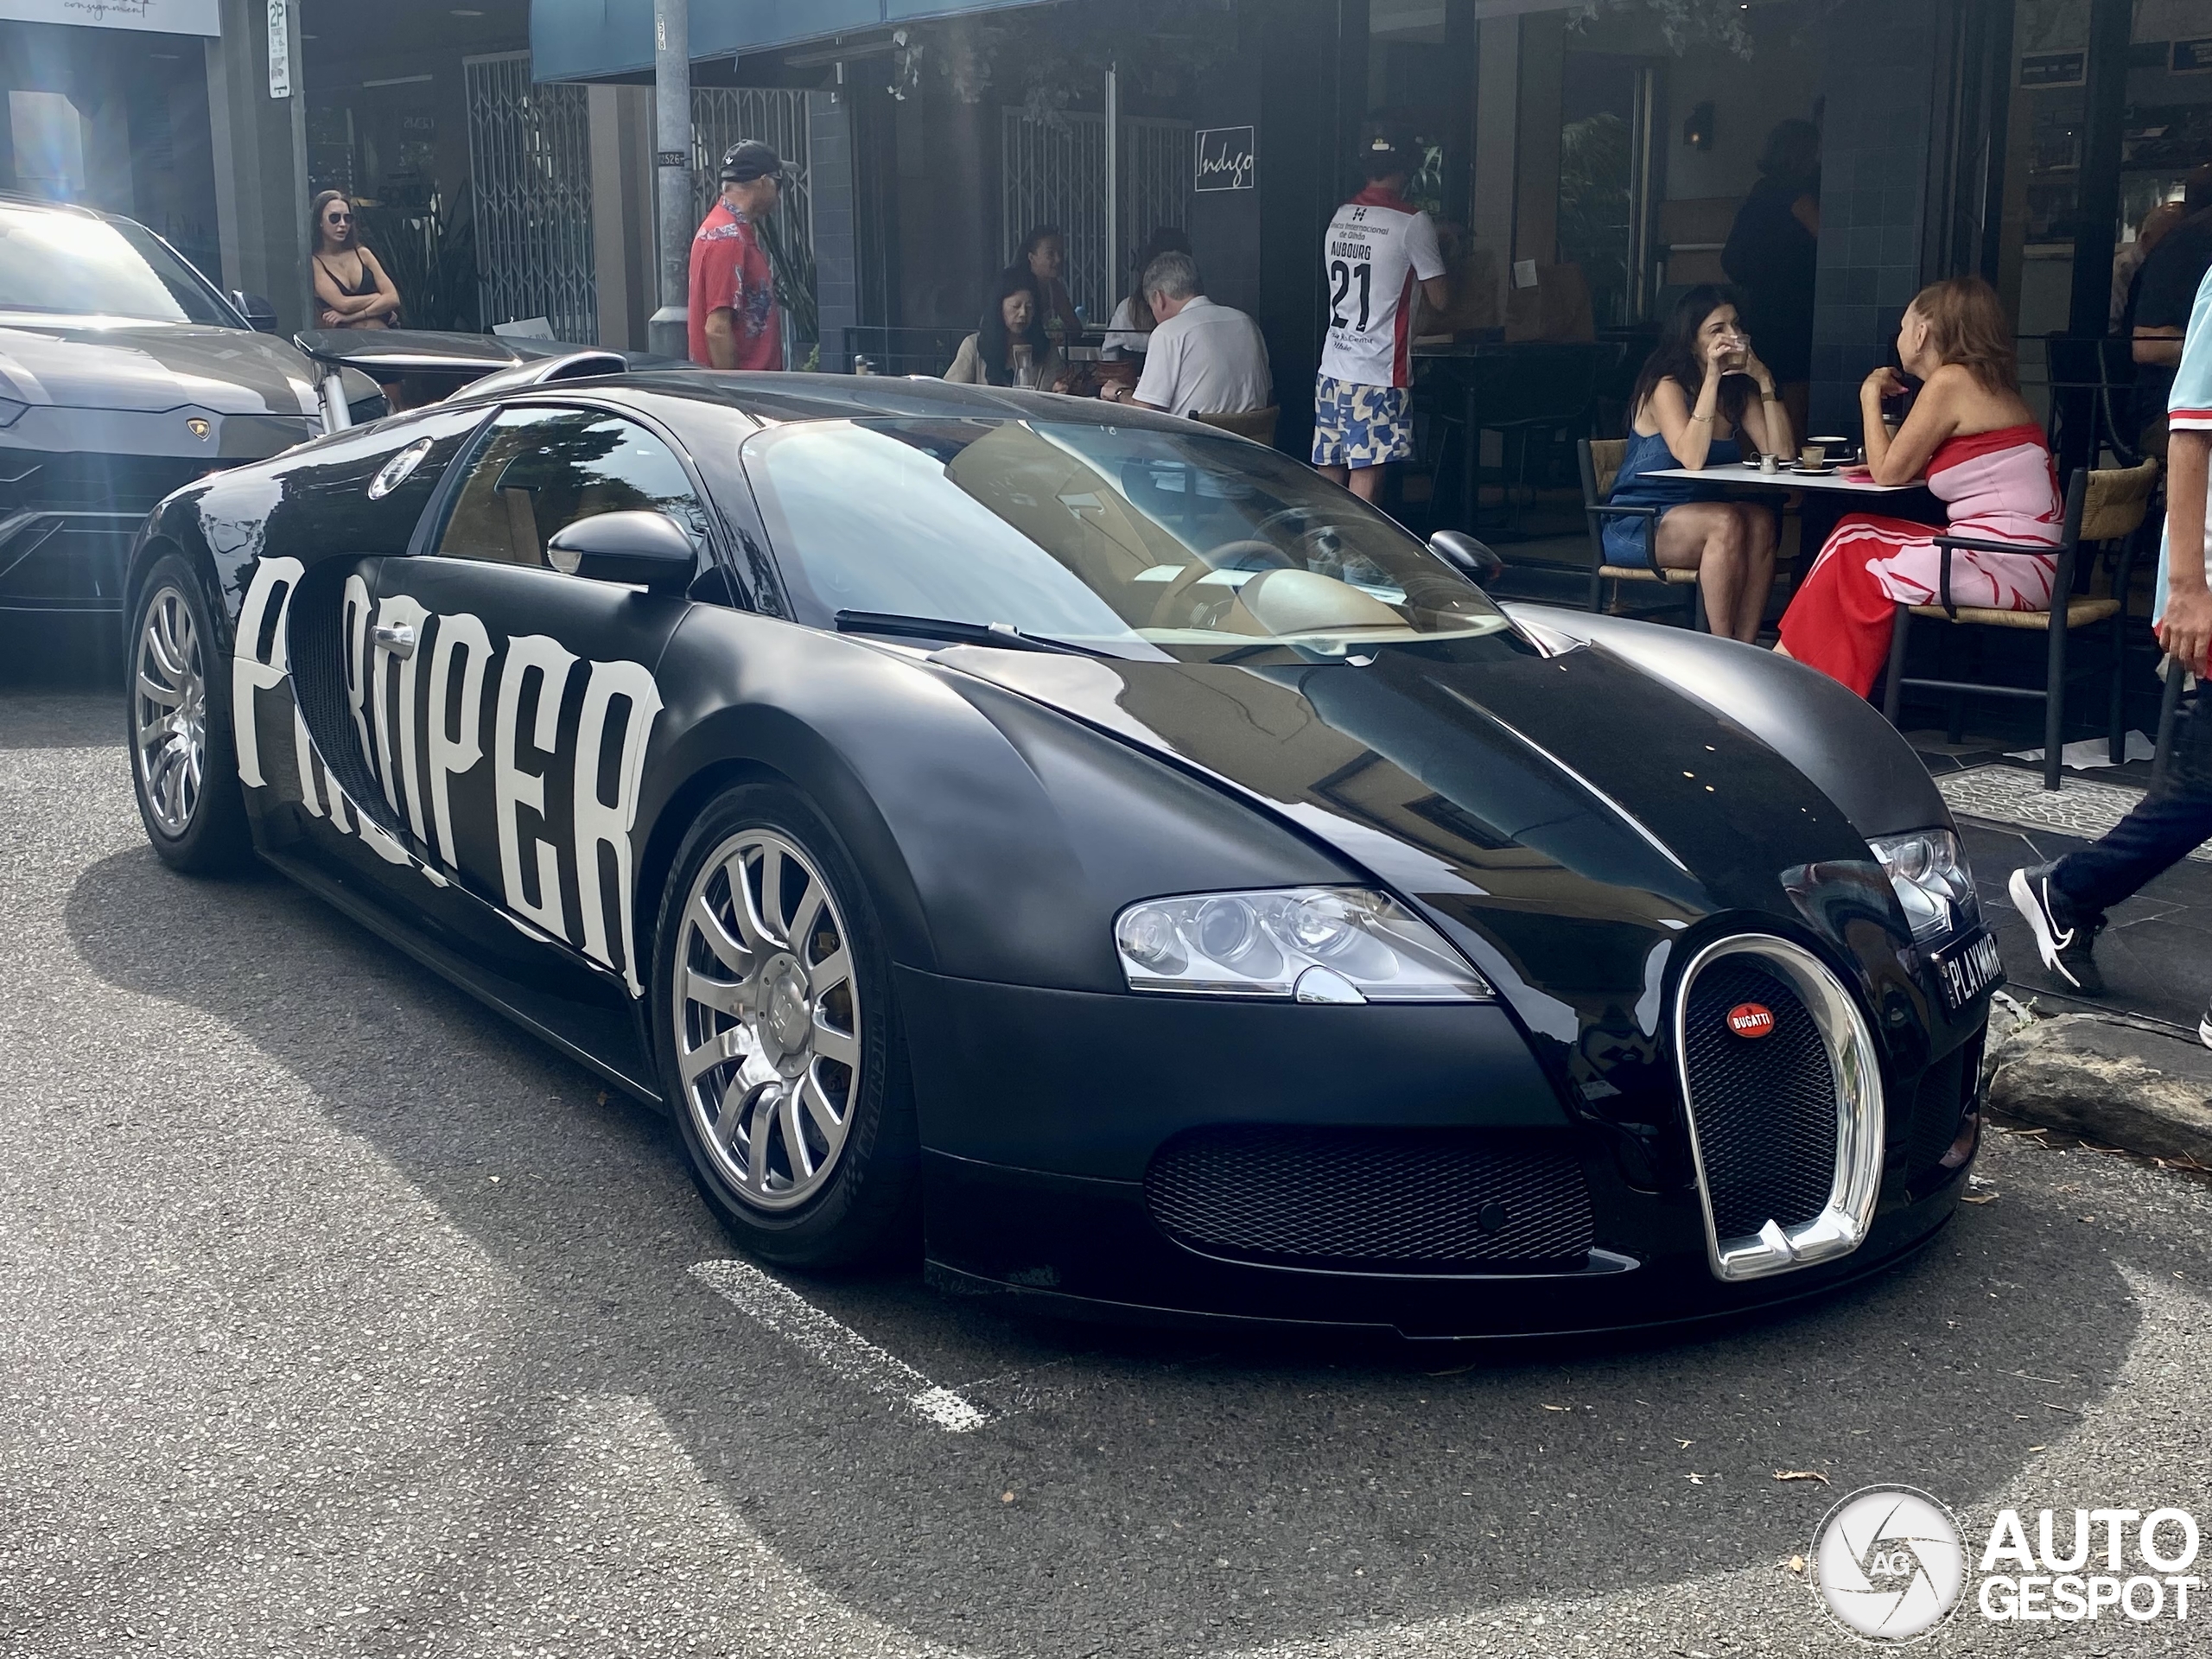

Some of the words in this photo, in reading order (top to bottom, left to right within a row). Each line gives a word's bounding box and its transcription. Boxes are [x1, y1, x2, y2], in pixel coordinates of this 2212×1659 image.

[270, 3, 283, 27] 2P
[1197, 131, 1253, 188] Indigo
[1331, 241, 1371, 260] AUBOURG
[1331, 260, 1371, 333] 21
[1732, 1013, 1770, 1029] BUGATTI
